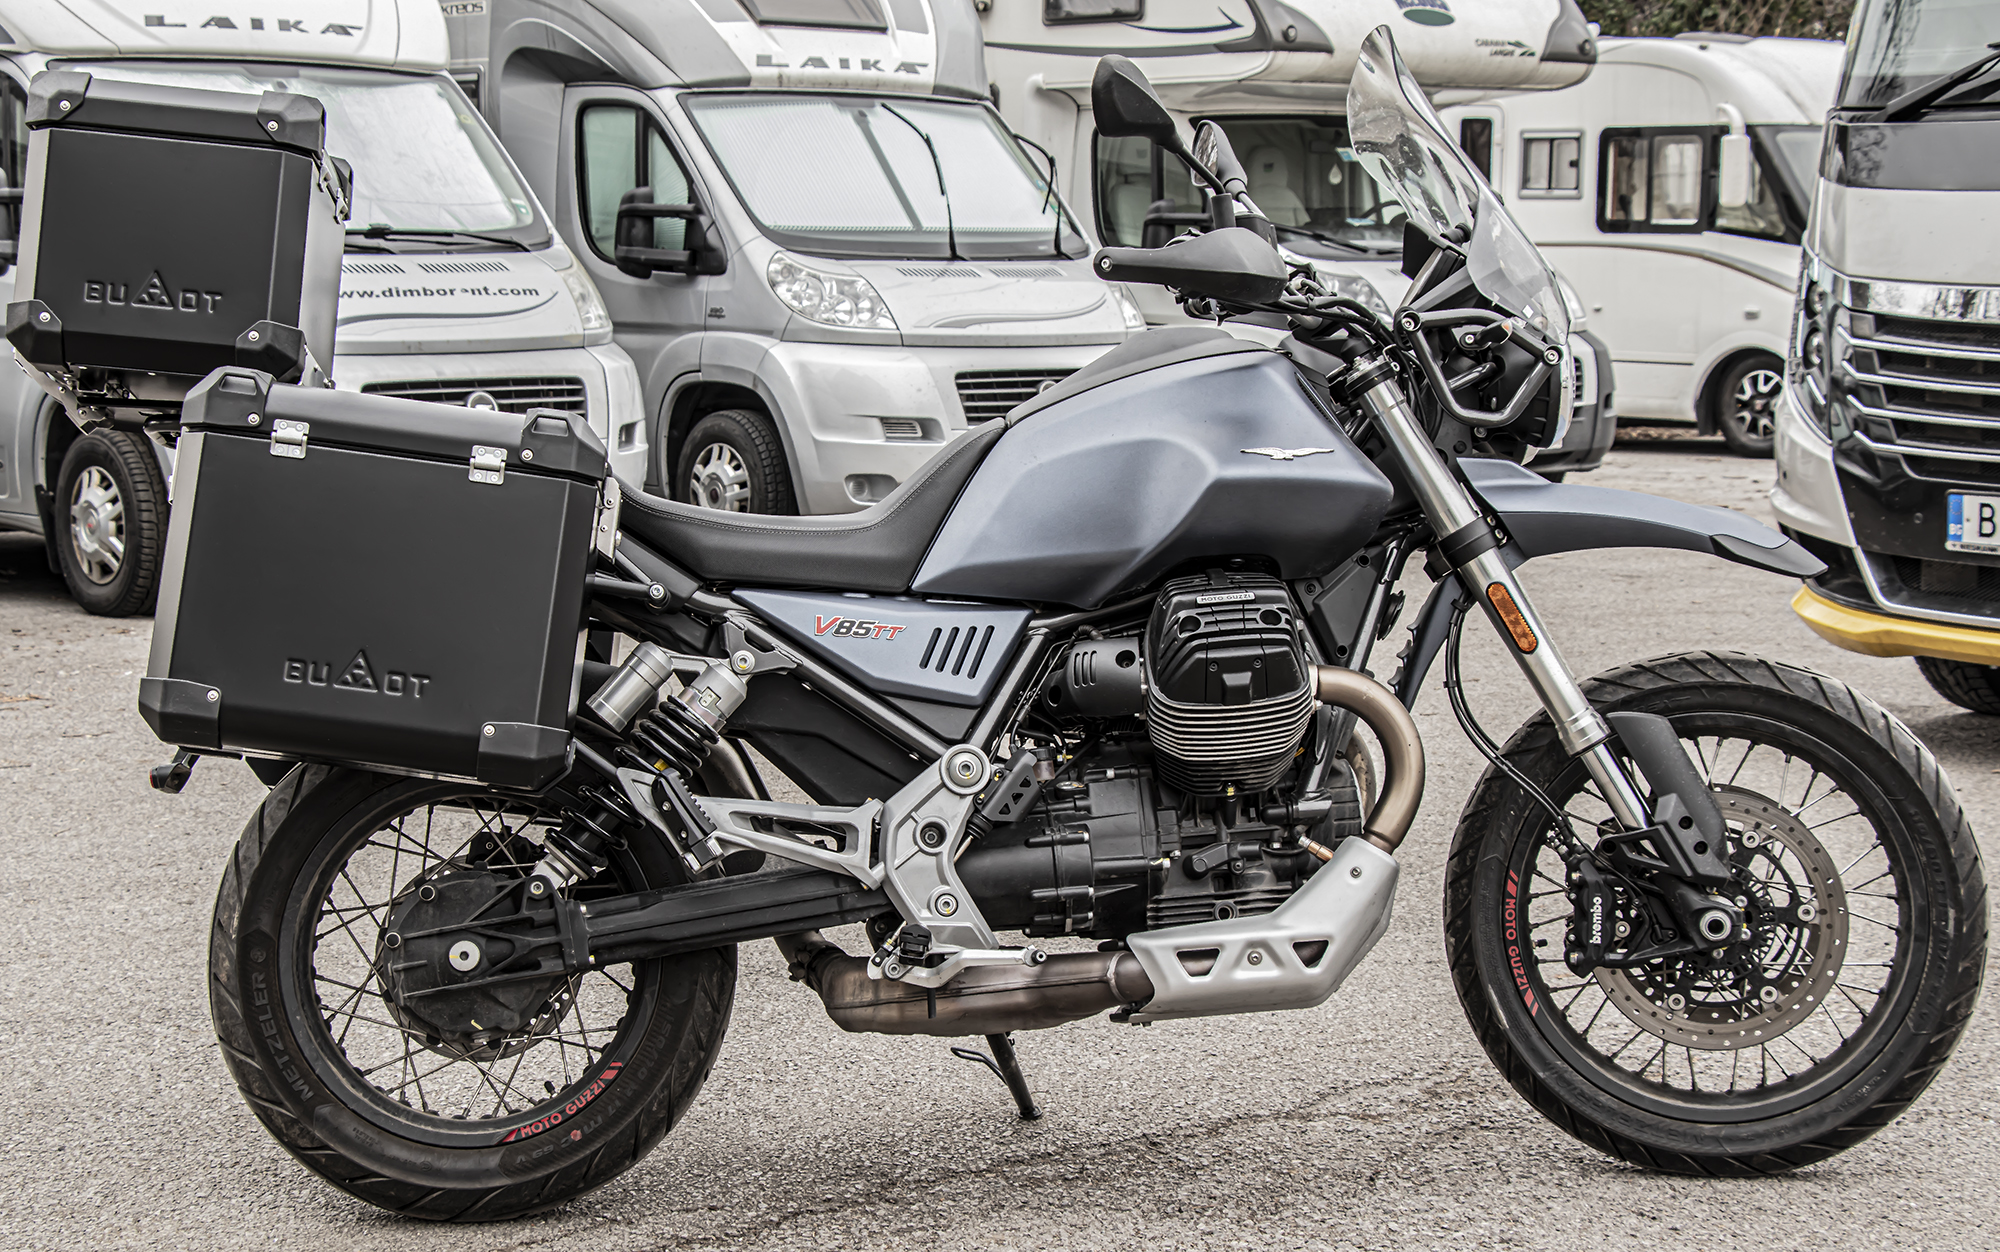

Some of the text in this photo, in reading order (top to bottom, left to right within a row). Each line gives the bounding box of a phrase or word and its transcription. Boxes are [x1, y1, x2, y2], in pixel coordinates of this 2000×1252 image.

[144, 14, 364, 37] LAIKA
[756, 54, 929, 74] LAIKA
[1979, 502, 1996, 538] B
[815, 614, 907, 640] V85TT
[1589, 896, 1603, 944] brembo
[1505, 899, 1530, 990] MOTO GUZZI
[252, 972, 314, 1102] METZELER
[520, 1079, 605, 1138] MOTO GUZZI
